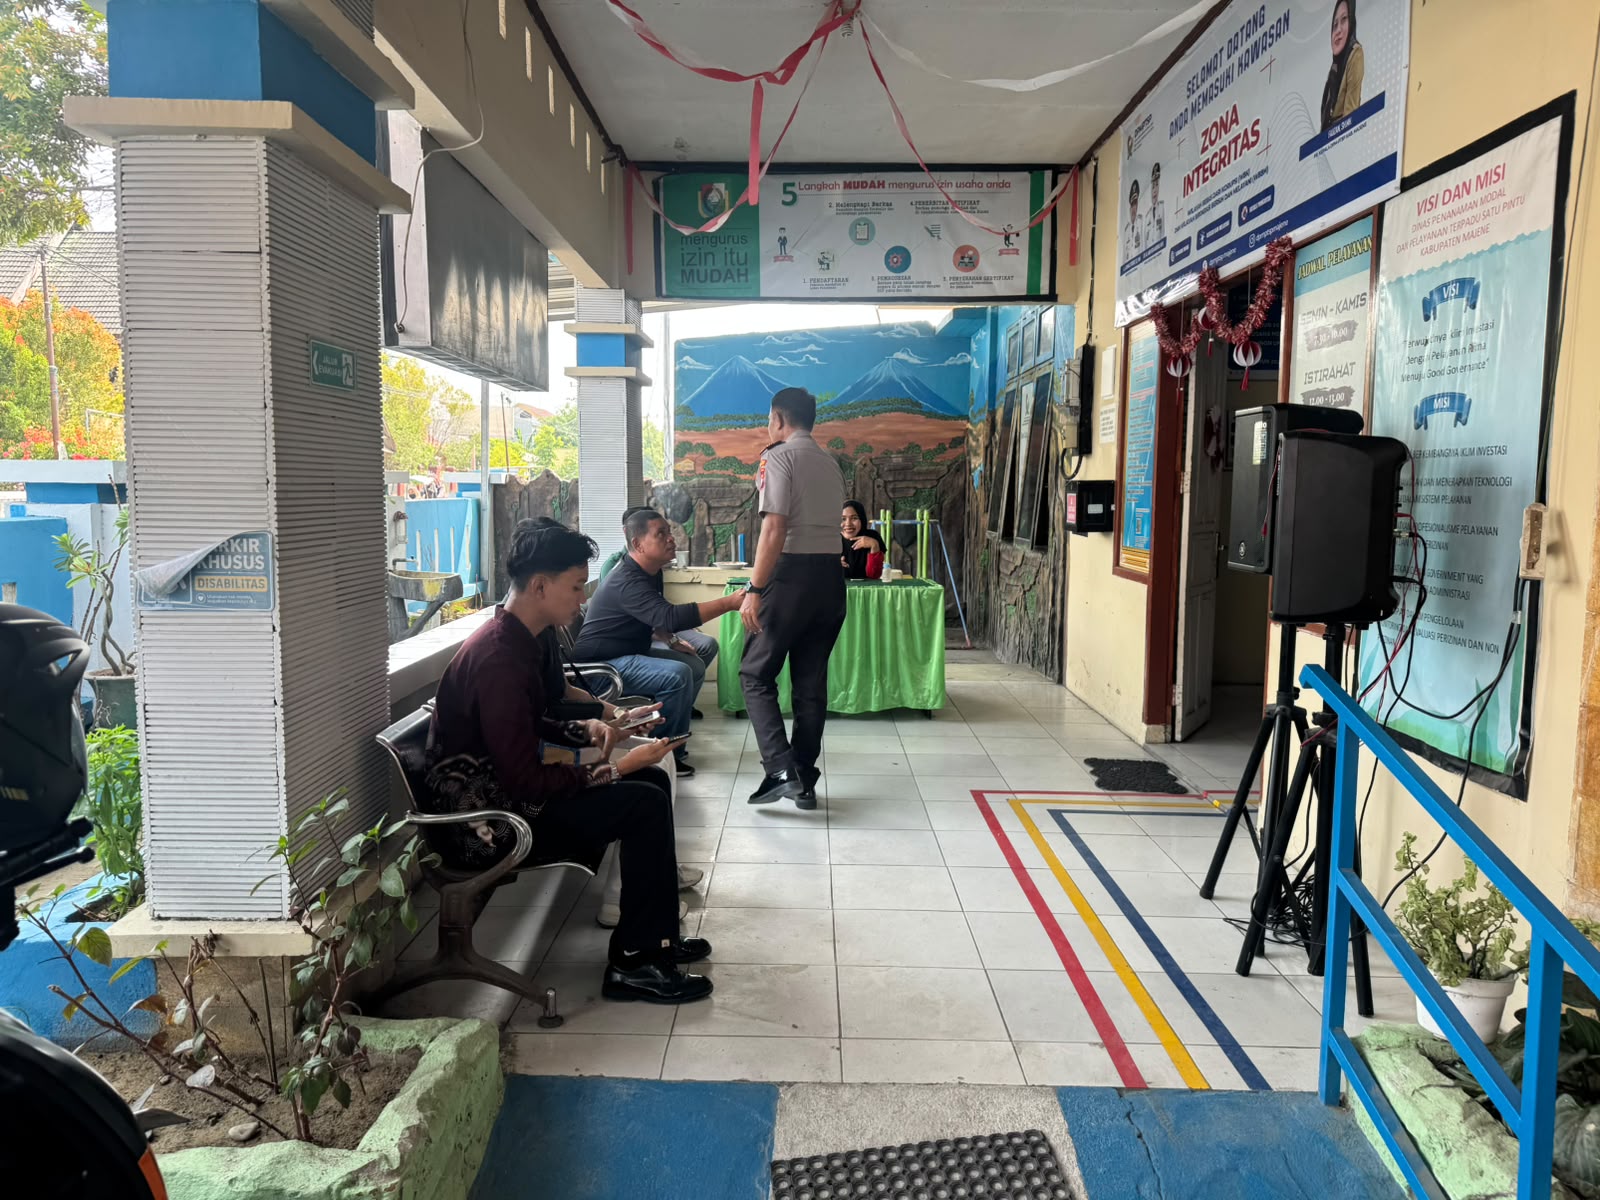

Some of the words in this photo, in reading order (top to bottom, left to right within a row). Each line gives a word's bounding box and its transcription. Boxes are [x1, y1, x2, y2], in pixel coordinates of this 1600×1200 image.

[1186, 46, 1224, 99] SELAMAT
[1227, 4, 1265, 61] DATANG
[1169, 107, 1189, 140] ANDA
[1190, 62, 1235, 120] MEMASUKI
[1237, 8, 1290, 77] KAWASAN
[1200, 103, 1240, 156] ZONA
[1182, 118, 1261, 199] INTEGRITAS
[781, 182, 798, 206] 5
[798, 181, 840, 191] Langkah
[843, 180, 886, 190] MUDAH
[888, 180, 935, 190] mengurus
[955, 180, 984, 189] usaha
[986, 180, 1011, 189] anda
[1416, 187, 1439, 217] VISI
[1442, 178, 1473, 207] DAN
[1475, 162, 1506, 193] MISI
[1411, 219, 1431, 234] DINAS
[1431, 200, 1478, 225] PENANAMAN
[1479, 187, 1507, 207] MODAL
[1409, 226, 1448, 249] PELAYANAN
[1449, 213, 1480, 234] TERPADU
[1481, 205, 1501, 221] SATU
[1501, 193, 1526, 213] PINTU
[681, 235, 748, 247] mengurus
[1420, 236, 1461, 257] KABUPATEN
[1462, 223, 1491, 243] MAJENE
[681, 247, 716, 267] izin
[724, 247, 748, 267] itu
[681, 268, 749, 283] MUDAH
[1297, 255, 1326, 281] JADWAL
[1442, 282, 1460, 300] VISI
[1335, 291, 1368, 315] KAMIS
[1303, 361, 1357, 386] ISTIRAHAT
[1426, 365, 1445, 379] Good
[1433, 395, 1451, 410] MISI
[1476, 440, 1508, 457] INVESTASI
[1474, 476, 1513, 487] TEKNOLOGI
[1460, 523, 1498, 537] PELAYANAN
[214, 538, 260, 553] RKIR
[197, 578, 265, 589] DISABILITAS
[1426, 567, 1466, 581] GOVERNMENT
[1466, 570, 1484, 585] YANG
[1424, 612, 1465, 629] PENGELOLAAN
[1467, 638, 1484, 650] DAN
[1484, 641, 1500, 655] NON
